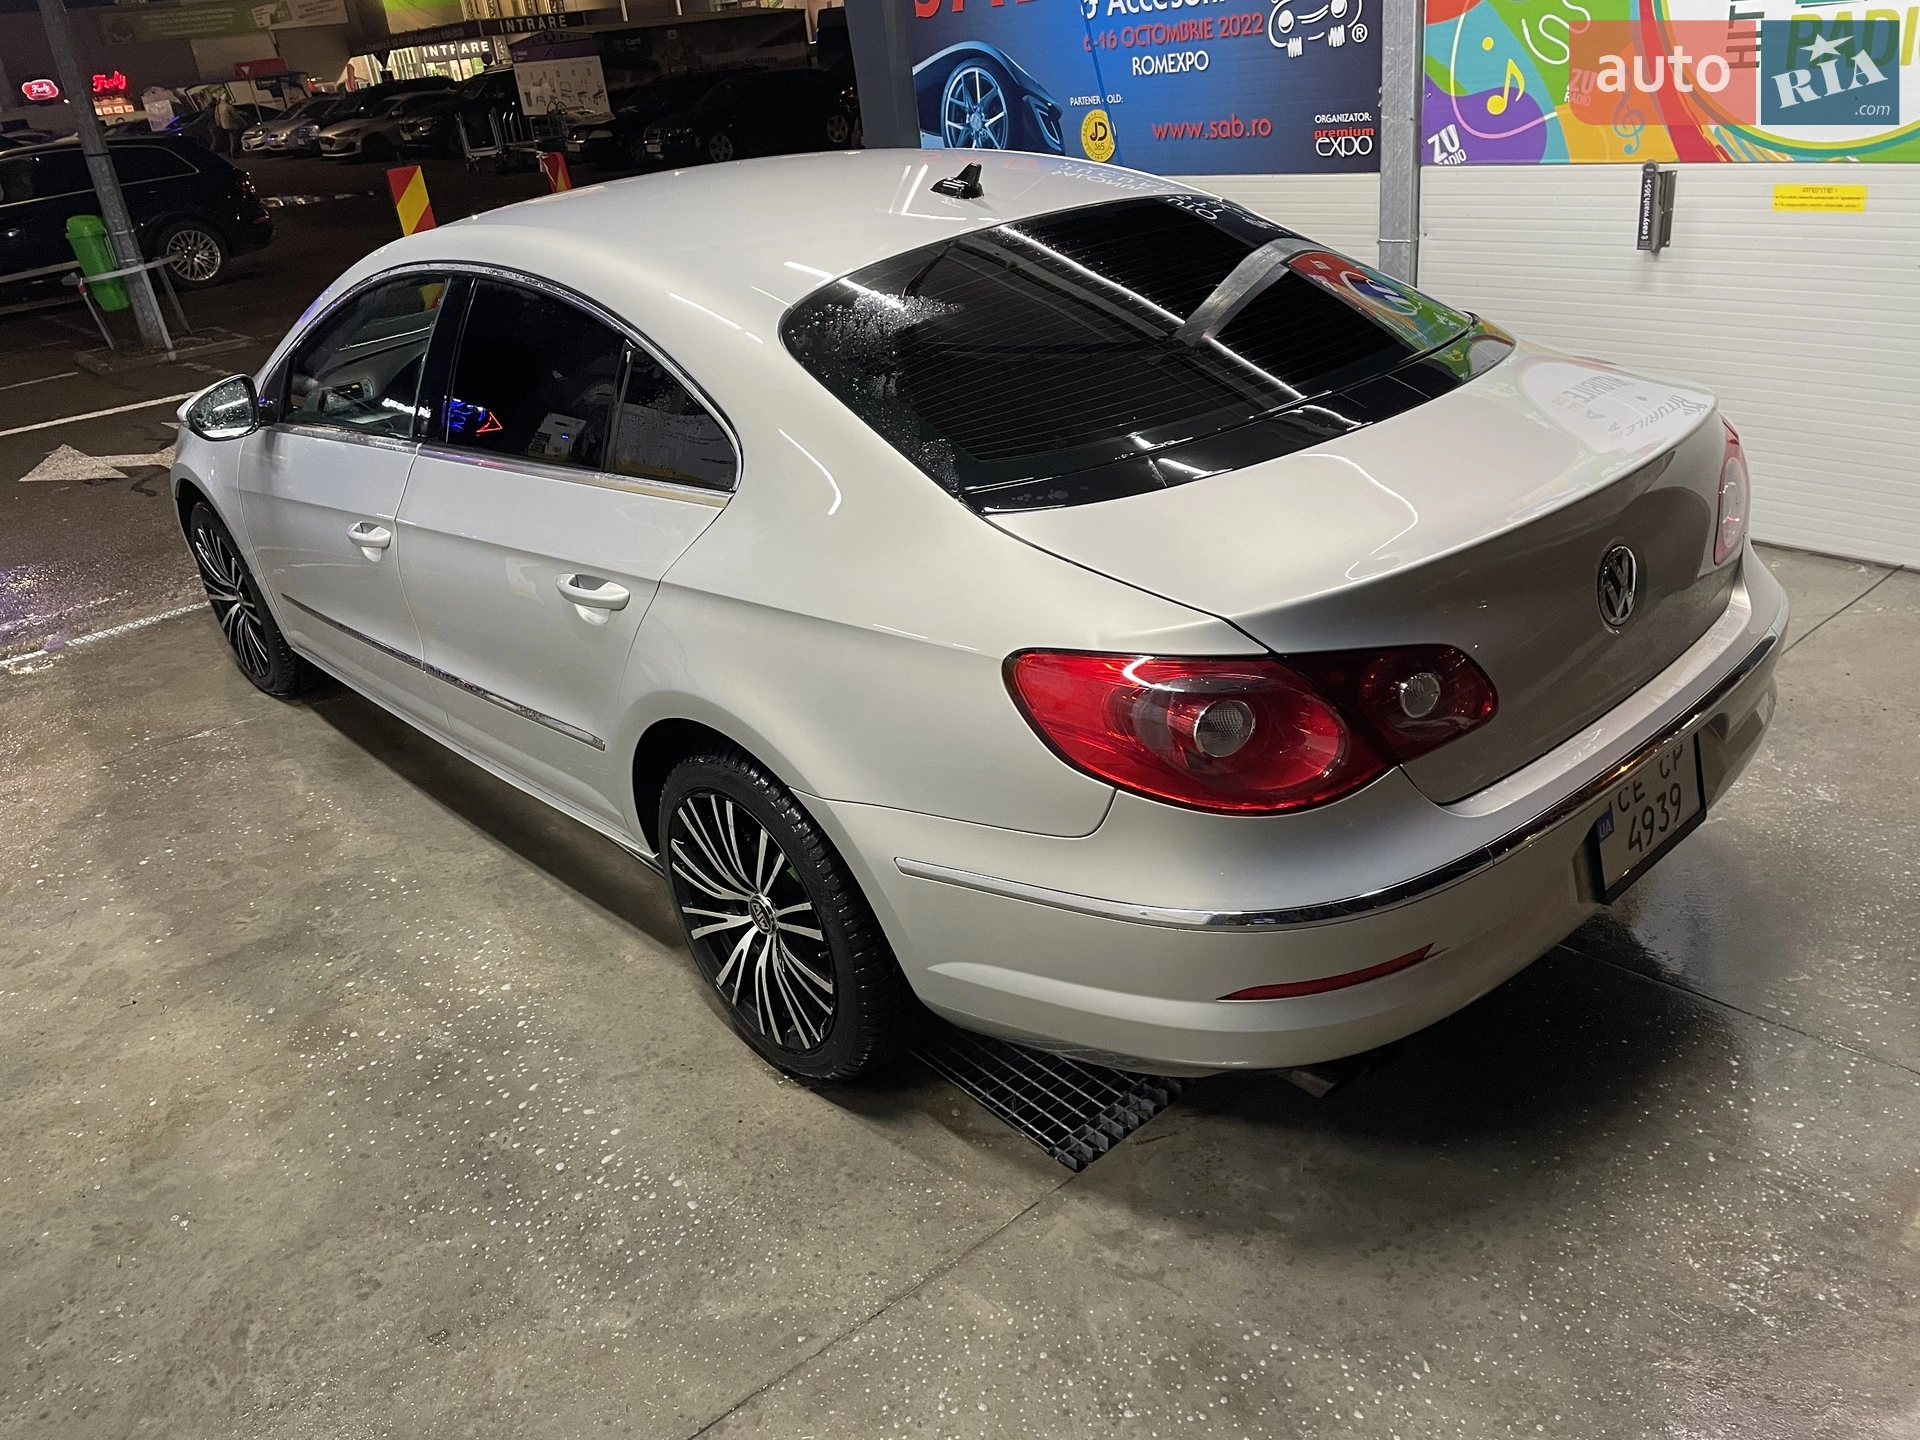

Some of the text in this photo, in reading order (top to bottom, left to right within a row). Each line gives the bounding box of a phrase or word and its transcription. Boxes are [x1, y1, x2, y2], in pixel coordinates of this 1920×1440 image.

[500, 15, 567, 33] INTRARE
[1121, 18, 1213, 48] OCTOMBRIE
[1218, 12, 1264, 37] 2022
[1786, 7, 1920, 70] RADI
[1132, 50, 1210, 76] ROMEXPO
[1069, 93, 1123, 106] PARTENER OLD:
[1152, 113, 1272, 140] www.sab.ro
[1314, 111, 1372, 124] ORGANIZATOR:
[1314, 126, 1374, 140] premium
[1427, 124, 1460, 164] ZU
[1439, 149, 1467, 166] ADIO
[1617, 780, 1646, 813] CE
[1598, 819, 1613, 840] UA
[1628, 783, 1681, 852] 4939
